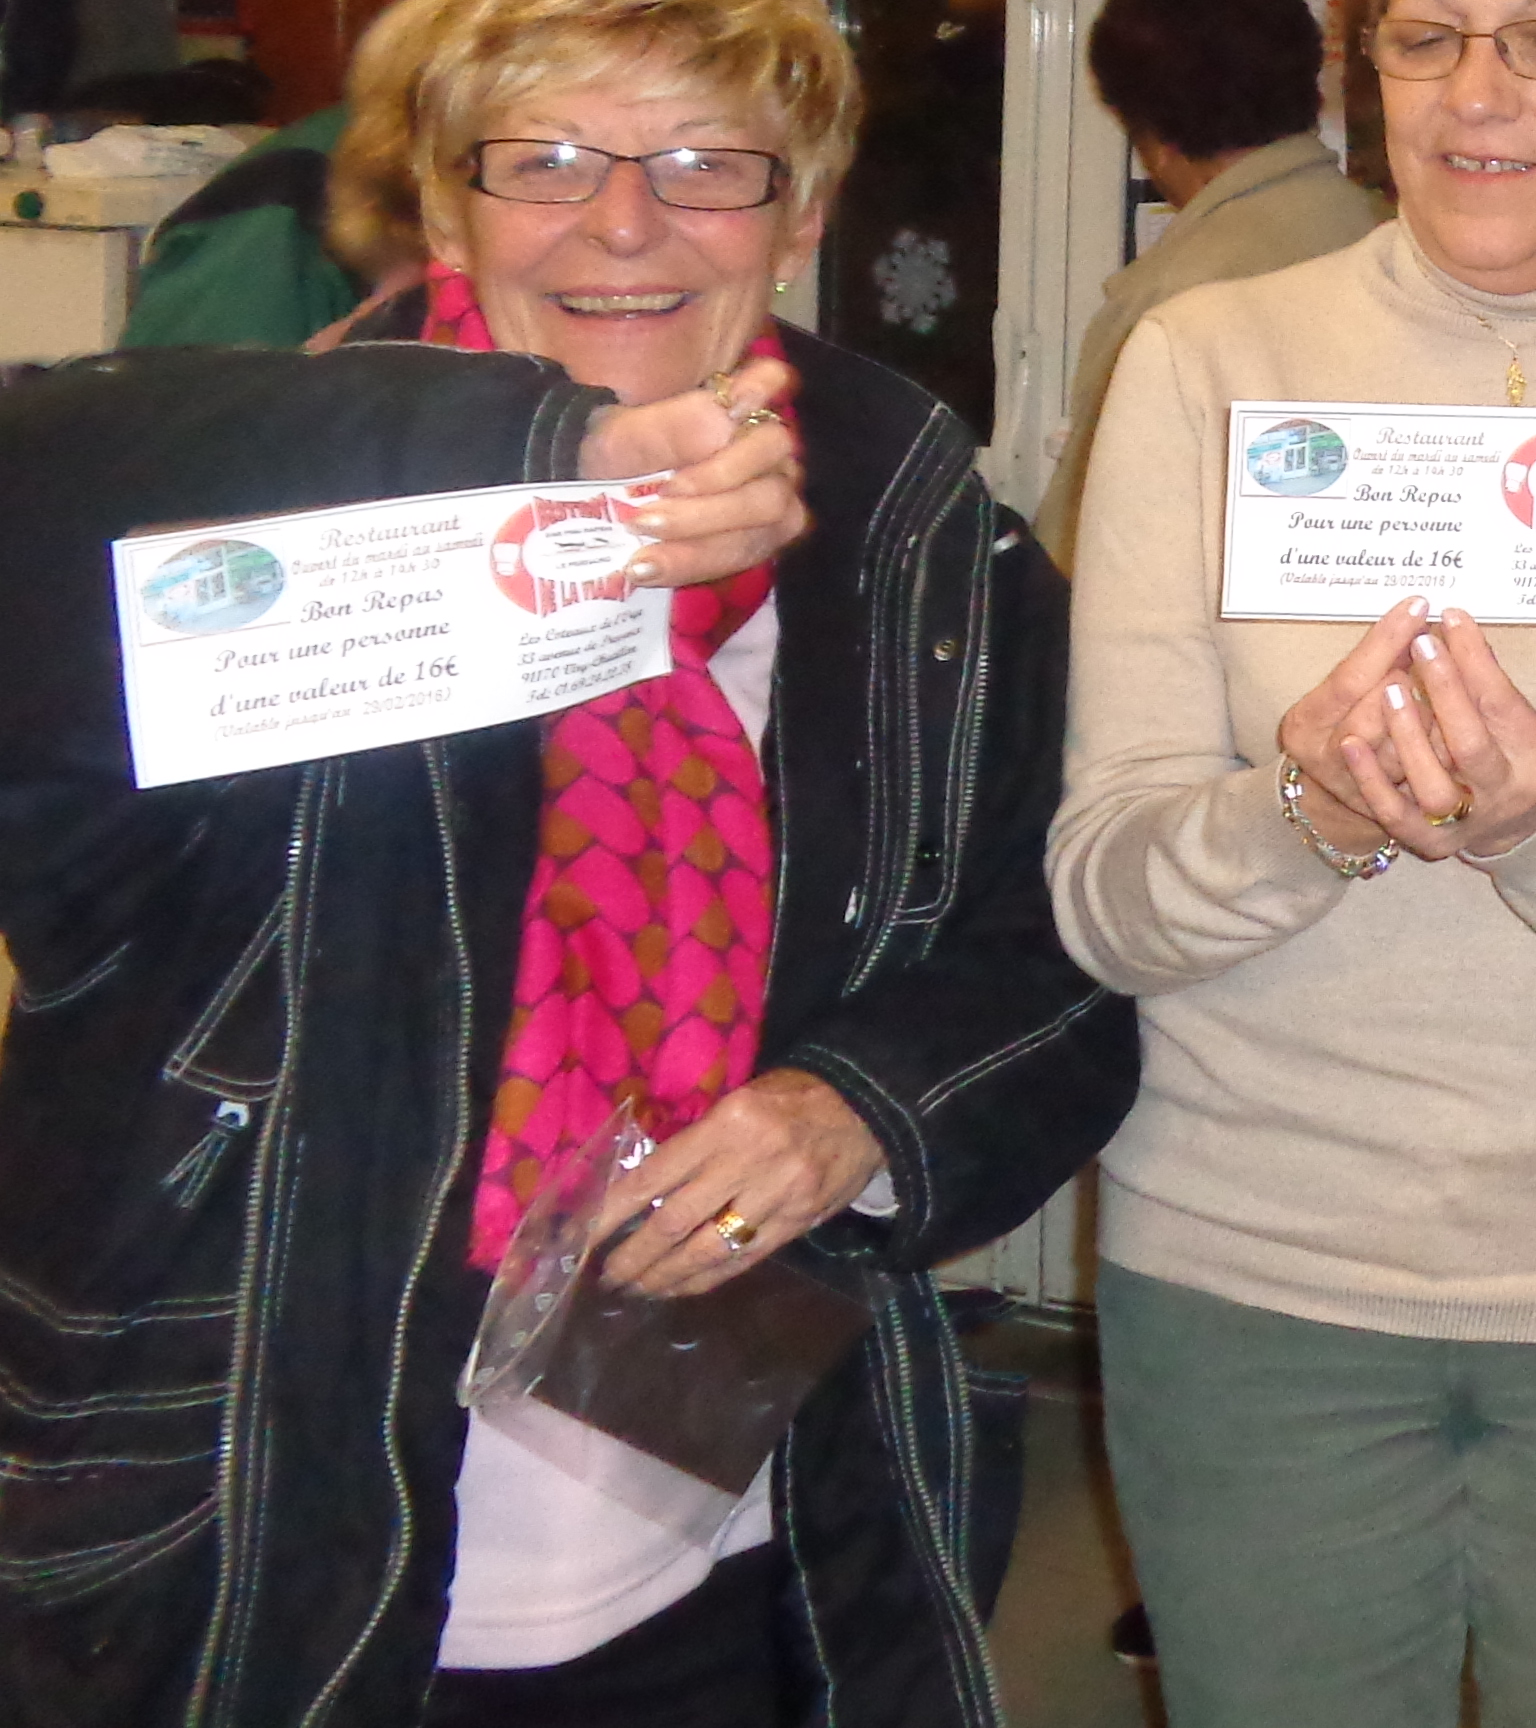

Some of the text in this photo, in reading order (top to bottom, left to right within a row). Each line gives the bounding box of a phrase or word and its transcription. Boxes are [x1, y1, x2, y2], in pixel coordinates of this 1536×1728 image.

[1376, 426, 1485, 446] Restaurant
[1353, 484, 1462, 508] Bon Repas
[319, 514, 462, 551] Restaurant
[1288, 511, 1464, 536] Pour une personne
[1280, 547, 1465, 569] d'une valeur de 16€
[300, 588, 443, 623] Bon Repas
[214, 622, 451, 673] Pour une personne
[210, 655, 461, 717] d'une valeur de 16€
